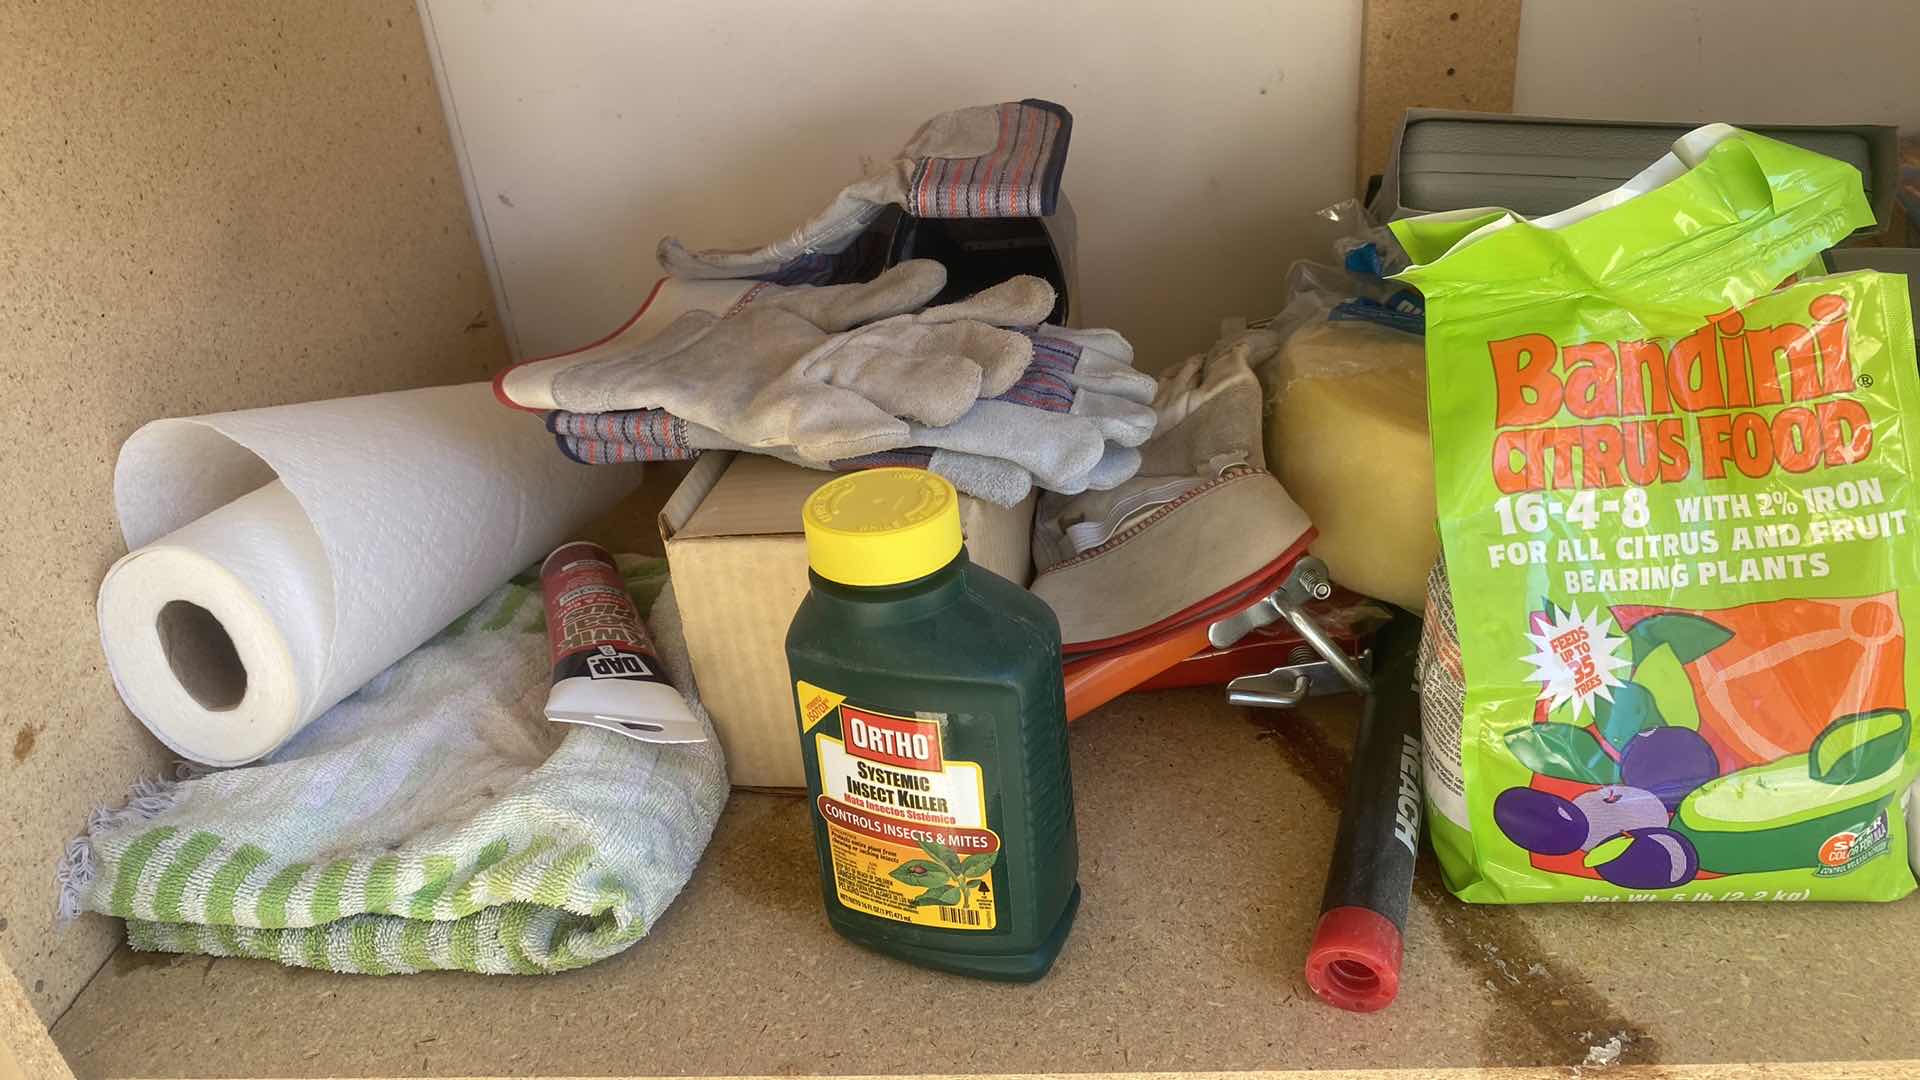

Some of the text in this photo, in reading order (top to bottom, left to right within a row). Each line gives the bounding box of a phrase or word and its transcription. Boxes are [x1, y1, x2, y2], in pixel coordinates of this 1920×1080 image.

[1488, 294, 1857, 429] Bandini
[1491, 399, 1873, 495] CITRUS FOOD
[1494, 477, 1885, 537] 16-4-8 WITH 2% IRON
[1488, 509, 1907, 569] FOR ALL CITRUS AND FRUIT
[1563, 552, 1831, 595] BEARING PLANTS
[1550, 626, 1589, 654] FEEDS
[1560, 641, 1591, 664] UP TO
[1567, 654, 1595, 685] 35
[1575, 674, 1604, 698] TREES
[850, 718, 929, 761] ORTHO
[846, 775, 949, 813] INSECT KILLER
[857, 761, 930, 791] SYSTEMIC
[844, 793, 864, 808] Mata
[865, 801, 906, 818] Insectos
[825, 803, 988, 849] CONTROLS INSECTS & MITES
